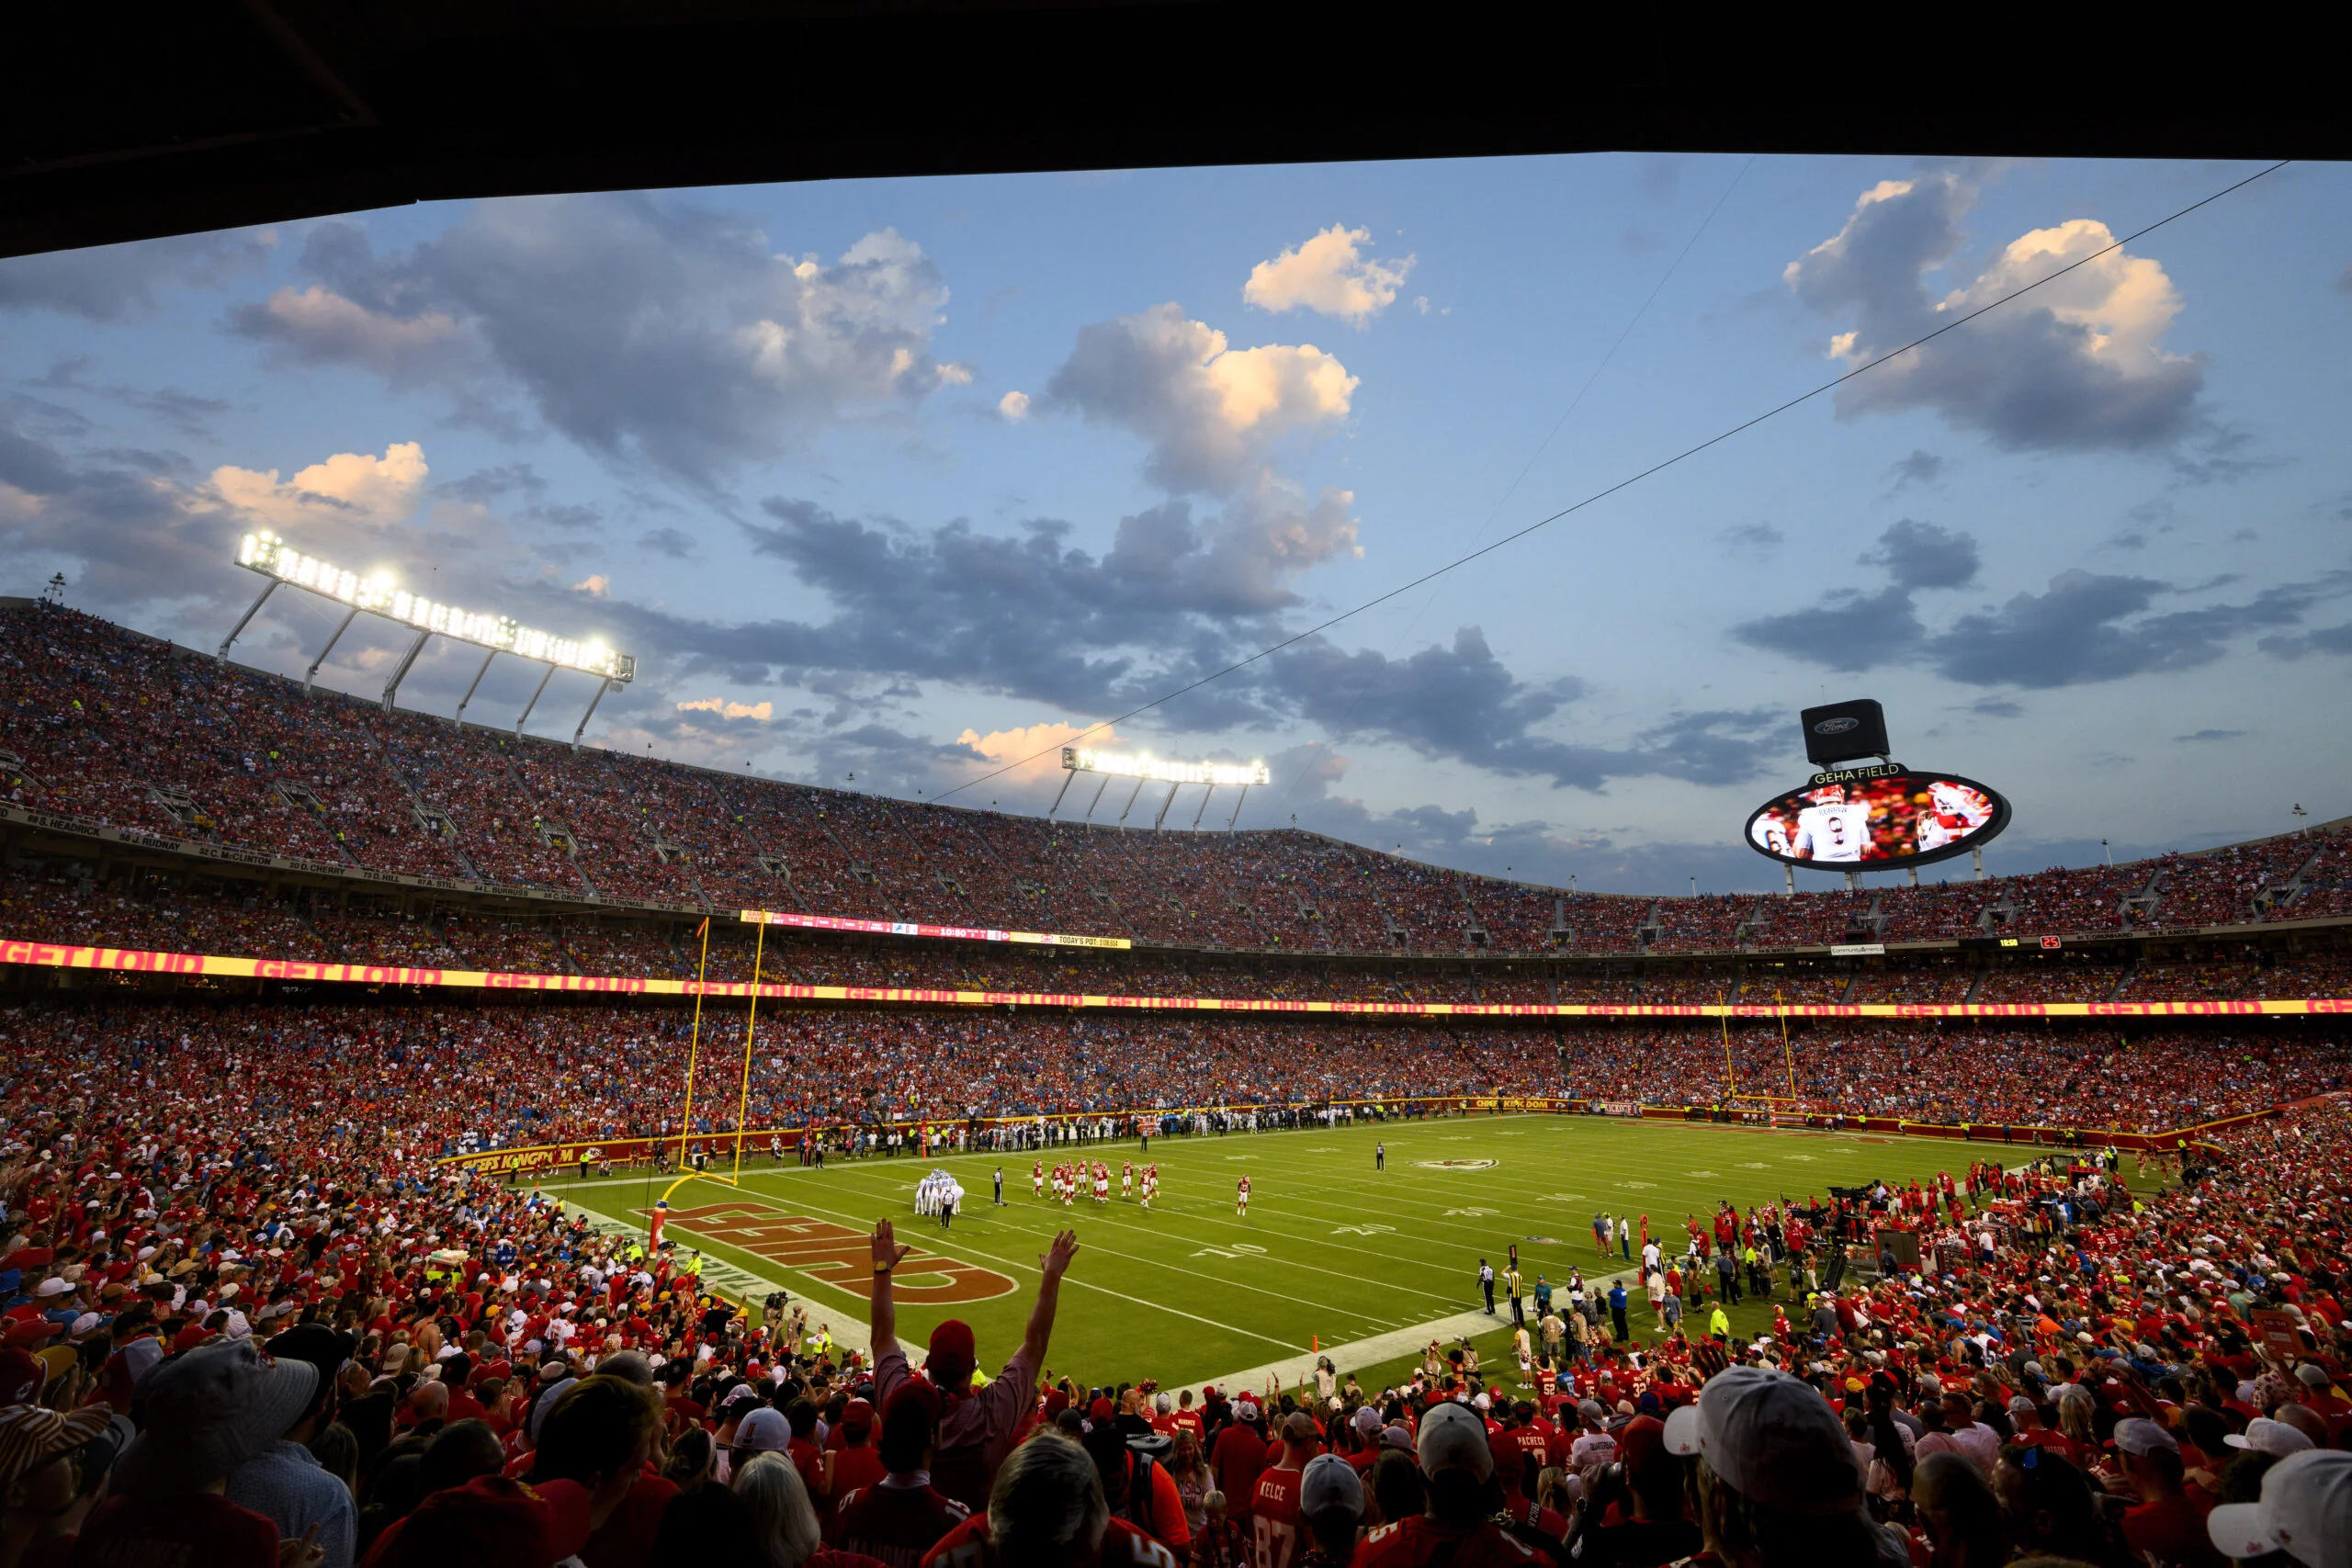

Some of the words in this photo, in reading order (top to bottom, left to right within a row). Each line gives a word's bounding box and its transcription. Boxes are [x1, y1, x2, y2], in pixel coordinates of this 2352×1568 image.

[1823, 720, 1850, 732] Ford
[1815, 770, 1855, 784] GEHA
[1859, 764, 1899, 779] FIELD
[50, 818, 100, 837] HEADRICK
[1828, 817, 1845, 846] 9
[142, 839, 181, 852] RUDNAY
[311, 864, 345, 875] CHERRY
[436, 881, 458, 889] STILL
[2167, 928, 2201, 936] ANDERS
[1059, 936, 1084, 945] TODAY'S
[2042, 937, 2059, 947] 25
[0, 940, 85, 965] GET
[254, 959, 335, 979] GET
[484, 972, 555, 988] GET
[682, 980, 737, 995] GET
[844, 987, 894, 999] GET
[983, 992, 1025, 1003] GET
[1106, 996, 1146, 1007] GET
[1220, 999, 1256, 1009] GET
[1330, 1002, 1369, 1011] GET
[1451, 1004, 1495, 1013] GET
[1586, 1005, 1634, 1014] GET
[1732, 1005, 1784, 1015] GET
[1895, 1004, 1957, 1015] GET
[2086, 1002, 2160, 1014] GET
[1330, 1223, 1397, 1236] 20
[1189, 1243, 1268, 1259] 10
[1544, 1383, 1555, 1396] 52
[1633, 1382, 1647, 1398] 32
[1517, 1436, 1545, 1447] PACHECO
[1259, 1480, 1286, 1502] KELCE
[1252, 1515, 1296, 1568] 87
